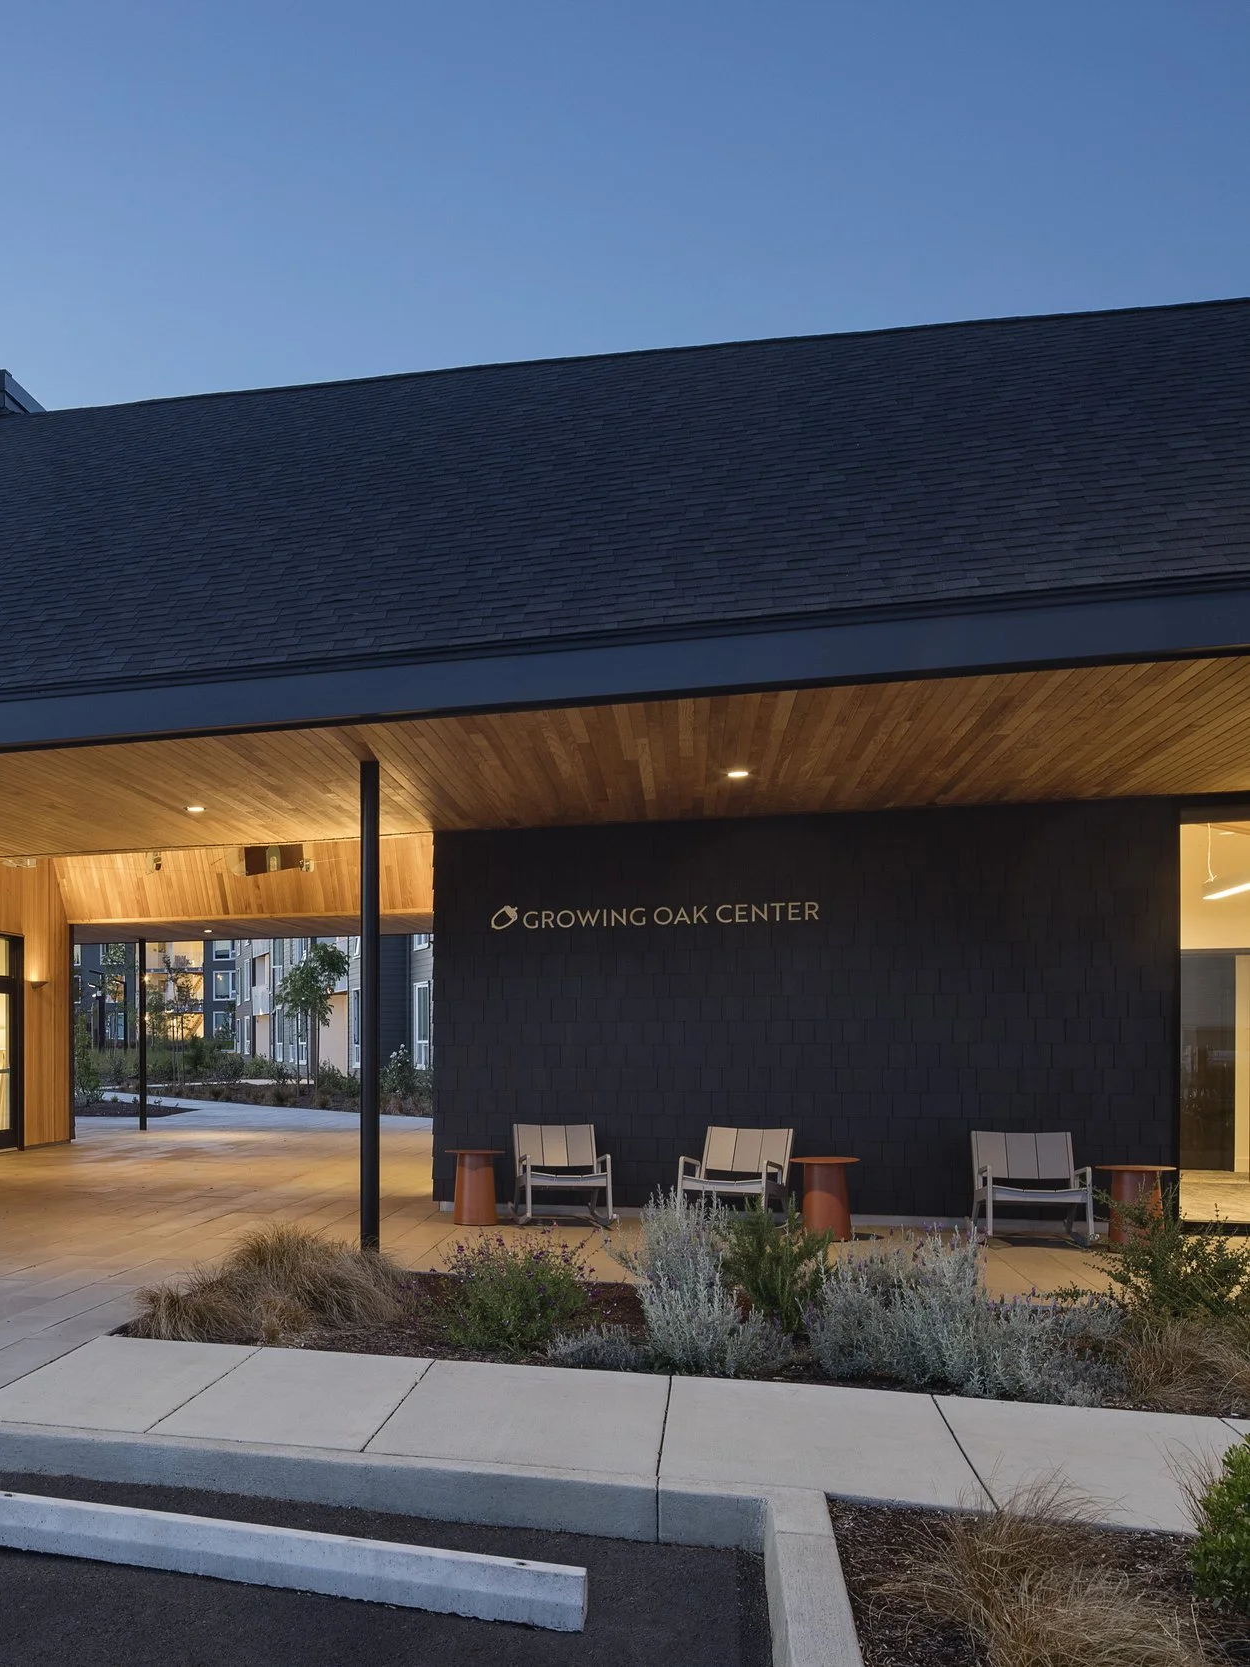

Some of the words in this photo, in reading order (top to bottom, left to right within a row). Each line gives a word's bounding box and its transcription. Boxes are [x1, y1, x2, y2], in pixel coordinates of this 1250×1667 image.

[522, 908, 647, 930] GROWING
[653, 905, 709, 926] OAK
[715, 901, 820, 924] CENTER
